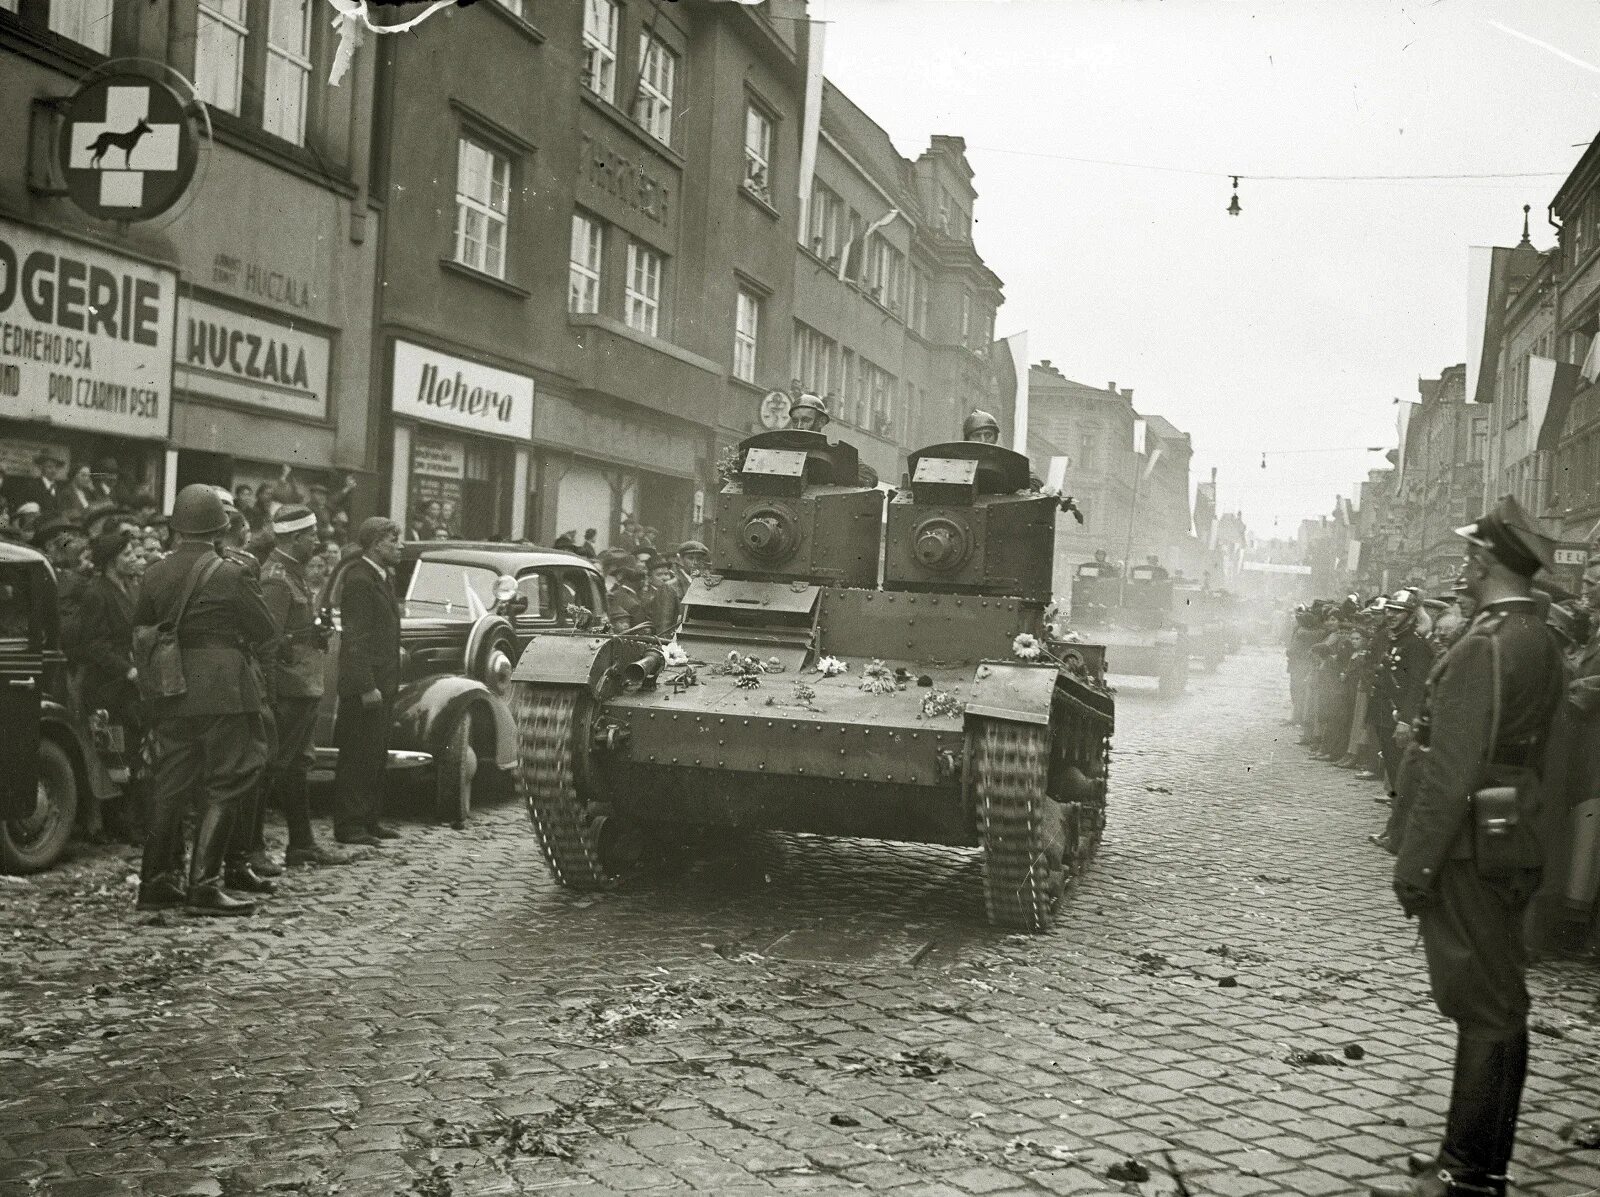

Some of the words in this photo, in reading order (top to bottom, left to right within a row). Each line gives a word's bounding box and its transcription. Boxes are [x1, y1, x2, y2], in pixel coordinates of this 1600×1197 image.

[0, 321, 61, 365] ERNEHO
[65, 336, 92, 370] PSA
[188, 317, 308, 389] HUCZALA
[417, 363, 513, 422] Nehera
